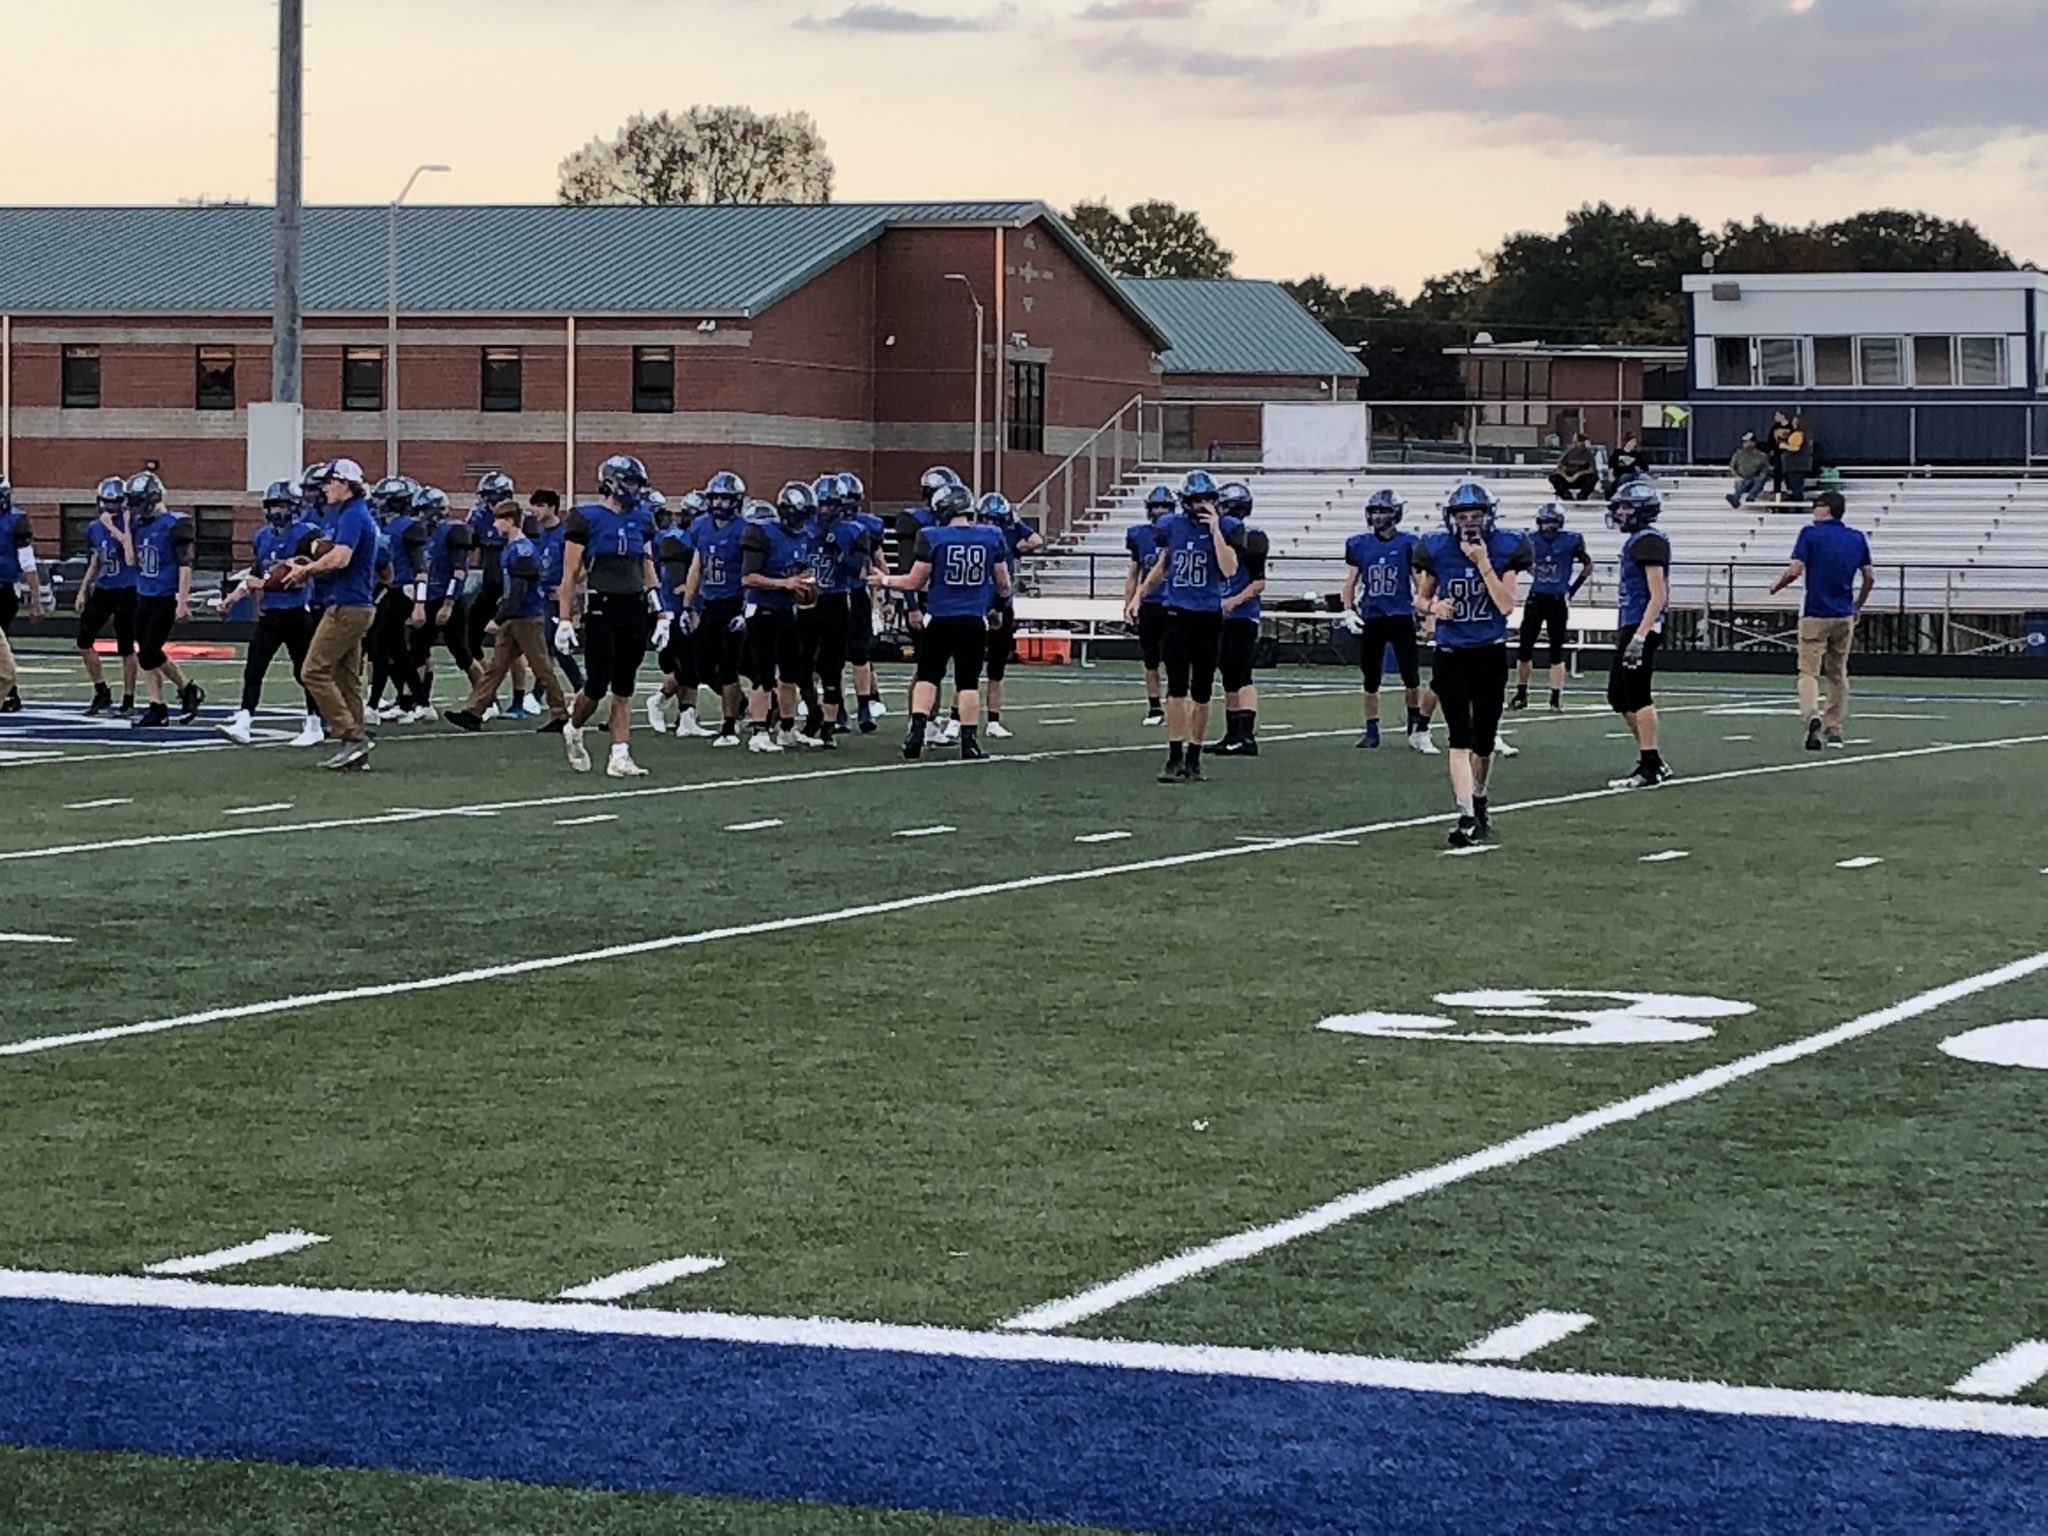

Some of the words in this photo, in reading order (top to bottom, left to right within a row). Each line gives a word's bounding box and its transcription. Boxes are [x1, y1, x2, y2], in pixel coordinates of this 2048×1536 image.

[944, 545, 986, 586] 58
[1172, 550, 1208, 587] 26
[1368, 564, 1398, 597] 66
[1447, 578, 1493, 622] 82
